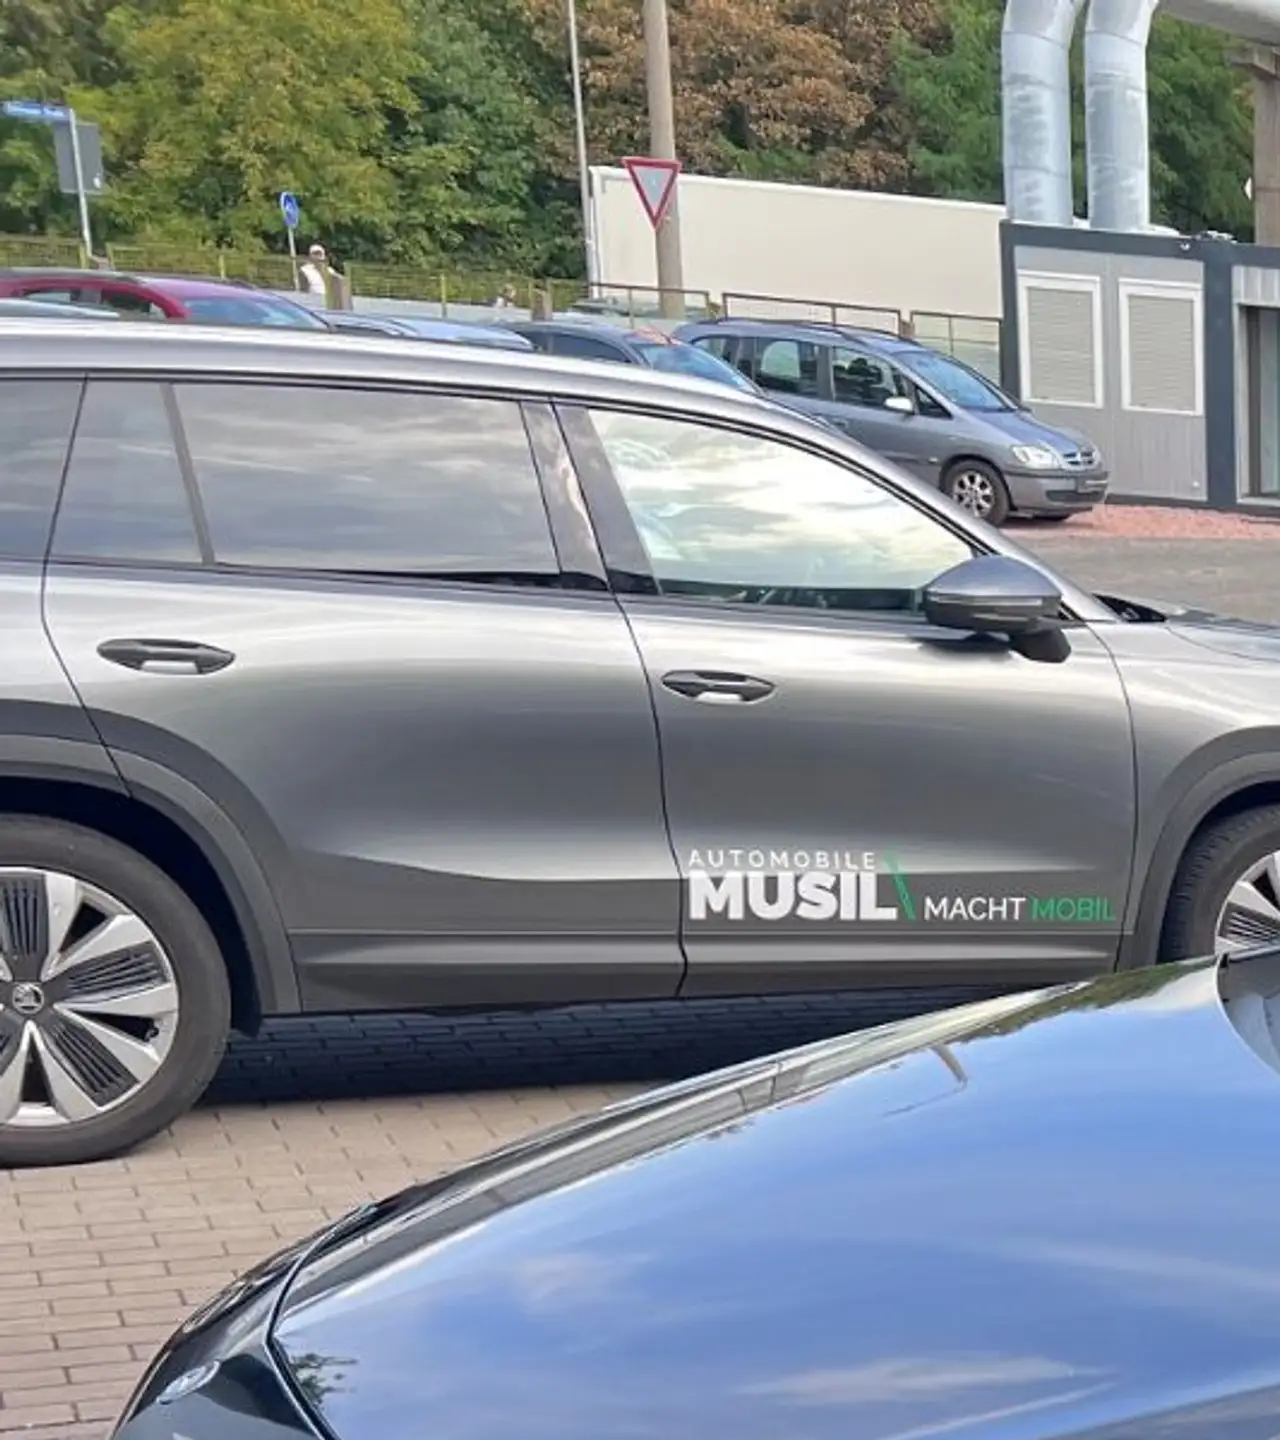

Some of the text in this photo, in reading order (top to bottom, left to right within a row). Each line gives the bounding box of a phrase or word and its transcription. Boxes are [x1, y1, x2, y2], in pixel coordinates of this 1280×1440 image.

[688, 849, 876, 870] AUTOMOBILE
[689, 869, 1117, 922] MUSIL MACHT MOBIL
